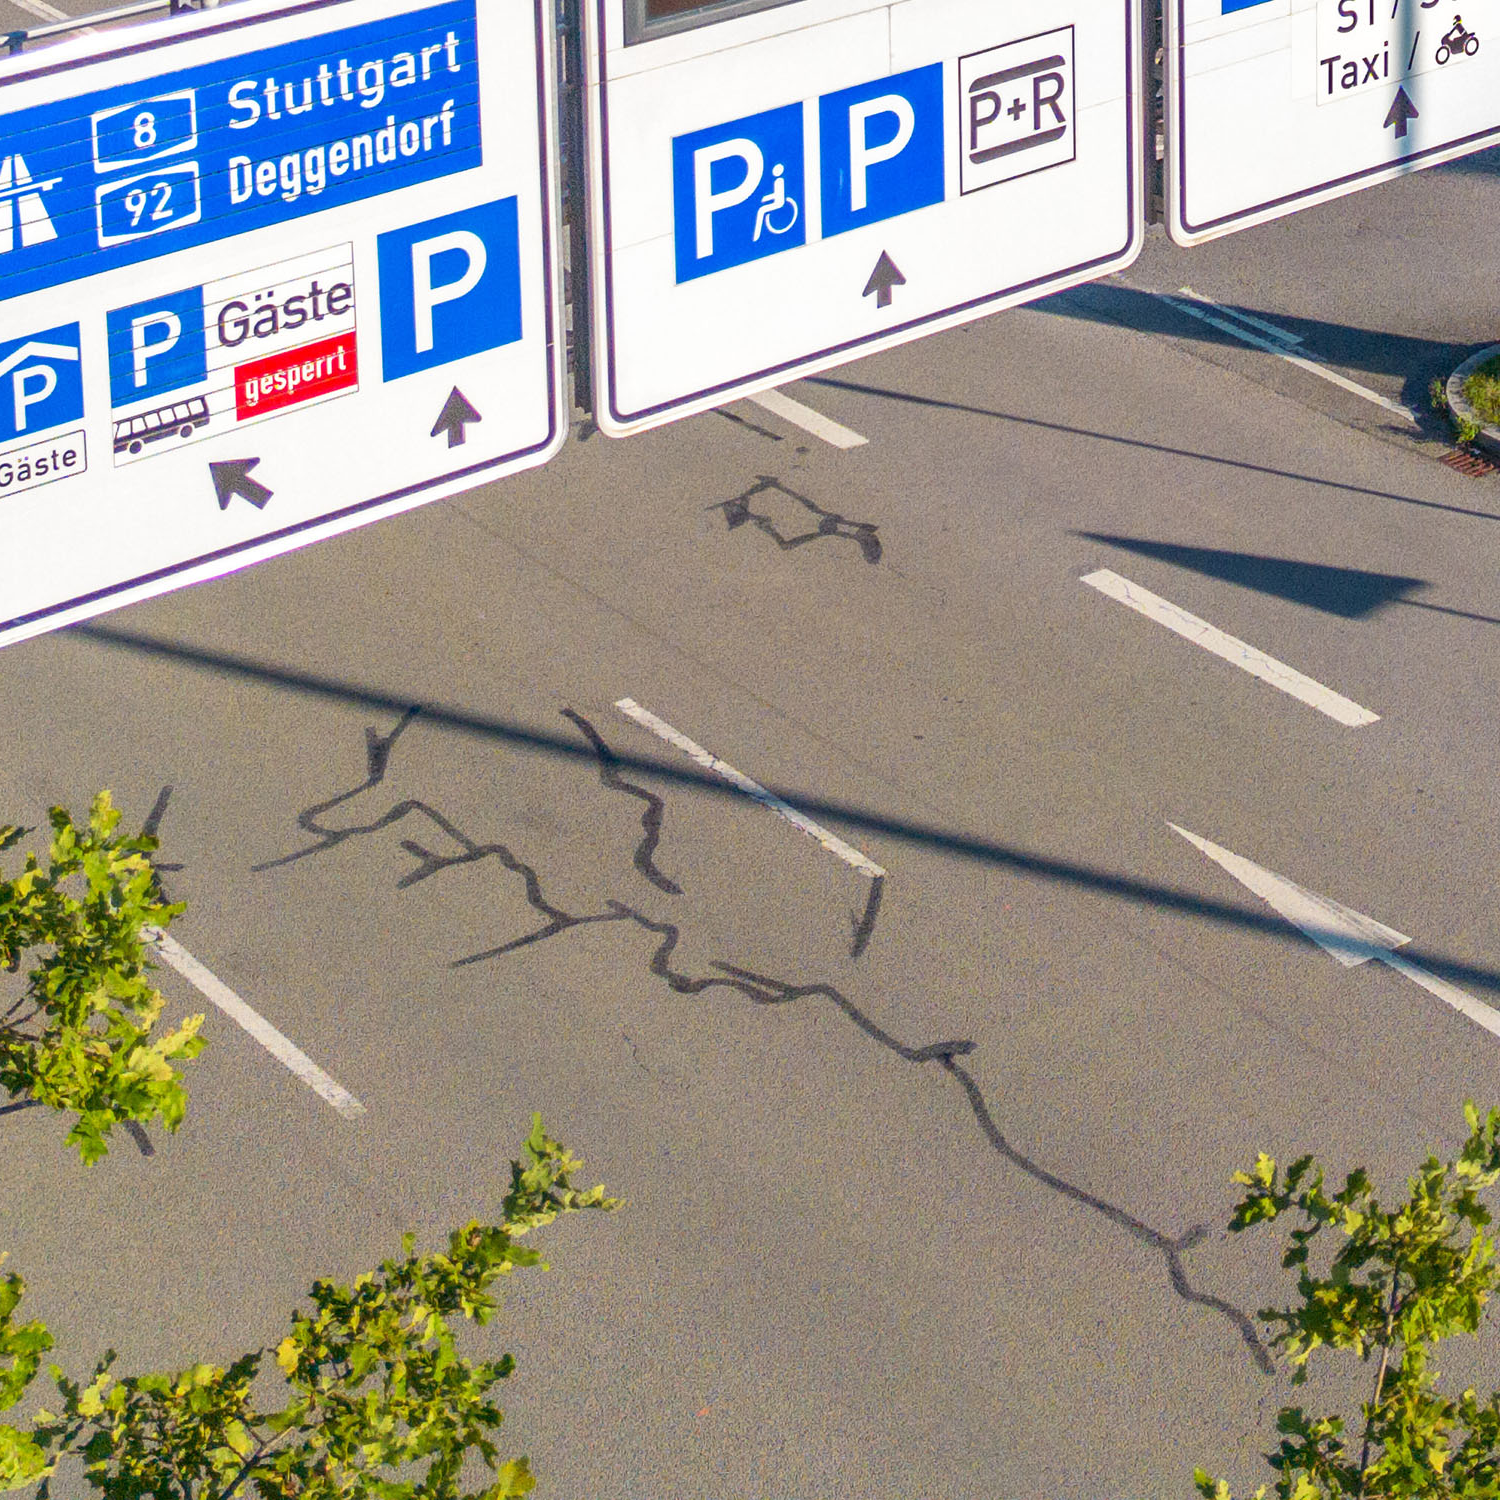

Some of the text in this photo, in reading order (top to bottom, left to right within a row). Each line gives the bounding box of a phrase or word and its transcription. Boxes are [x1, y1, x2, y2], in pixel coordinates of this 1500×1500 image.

[133, 32, 461, 148] 8 Stuttgart
[971, 73, 1064, 148] P+R
[1320, 44, 1391, 97] Taxi
[123, 102, 455, 228] 92 Deggendorf
[696, 139, 764, 258] P
[851, 95, 913, 210] P
[132, 273, 353, 389] P Gäste
[412, 230, 486, 352] P
[12, 363, 58, 432] P
[244, 346, 348, 405] gesperrt
